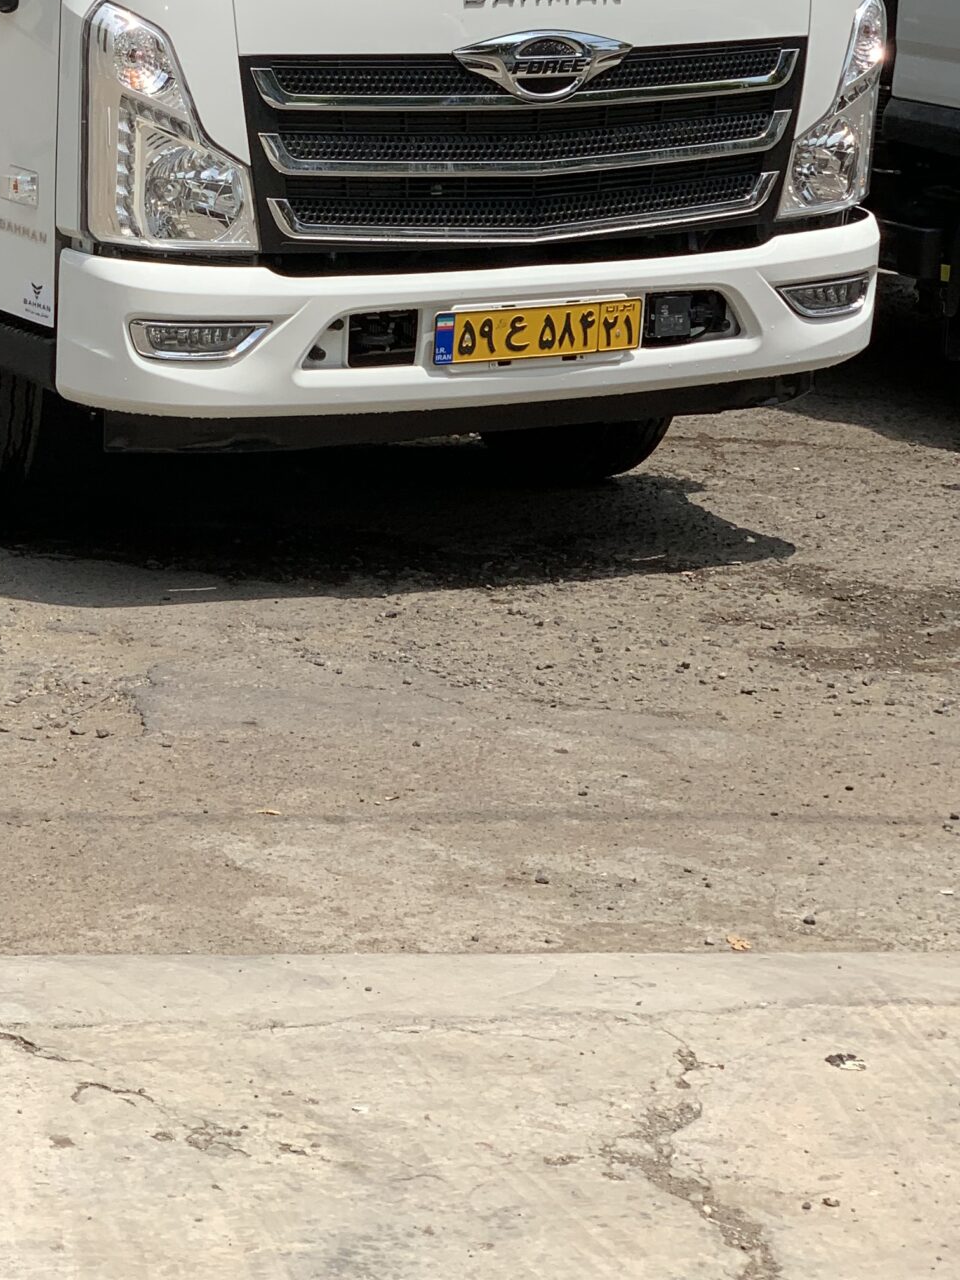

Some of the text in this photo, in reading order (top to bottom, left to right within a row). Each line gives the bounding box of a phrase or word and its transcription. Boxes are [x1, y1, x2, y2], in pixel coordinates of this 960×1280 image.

[510, 58, 589, 76] FORCE
[23, 297, 52, 313] BAHMAN
[435, 353, 452, 362] IRAN
